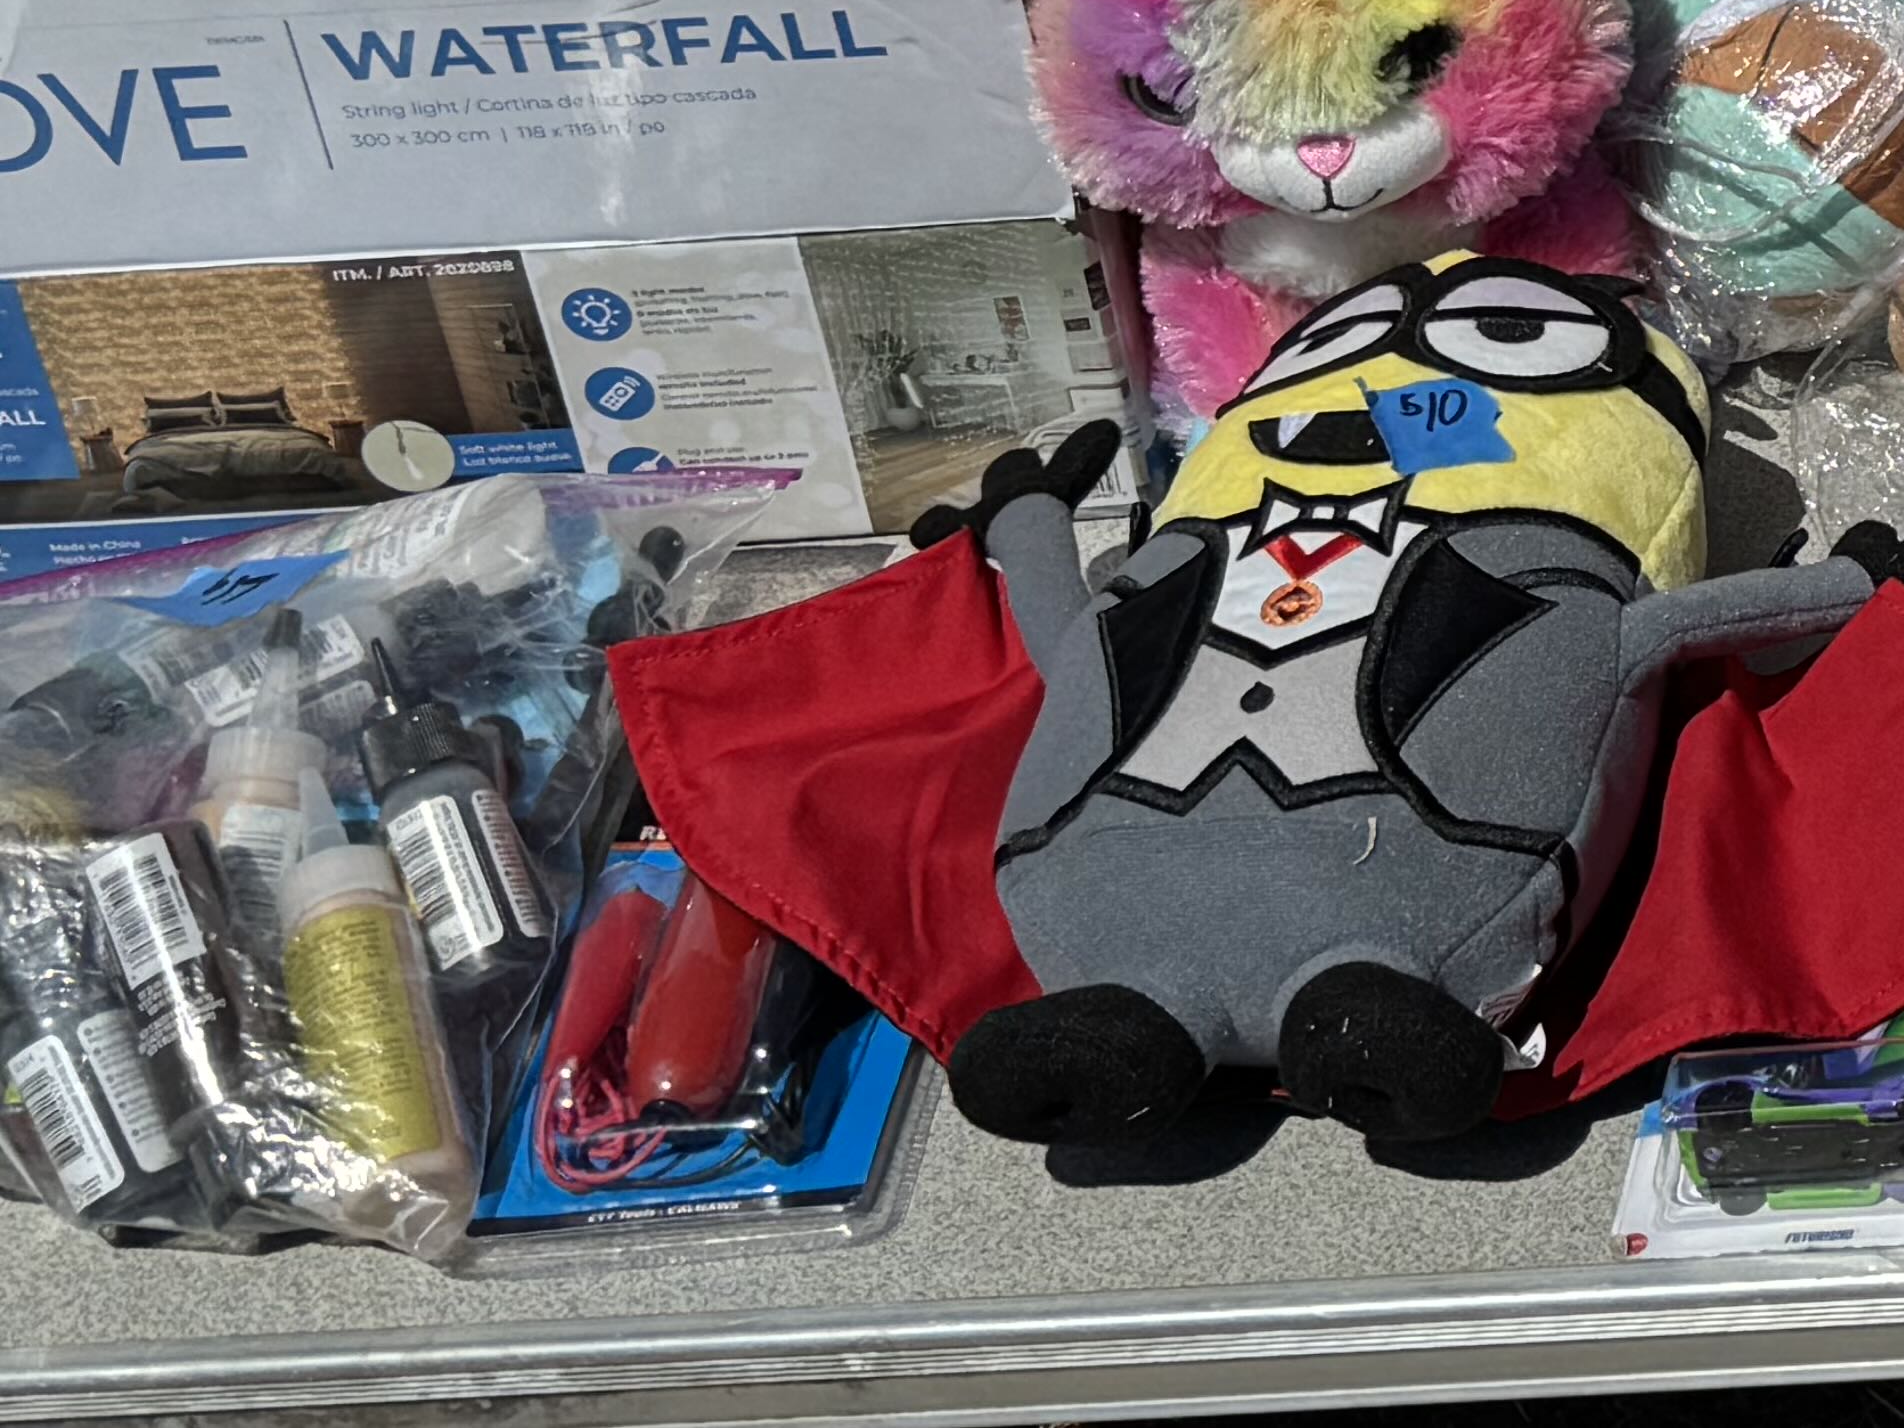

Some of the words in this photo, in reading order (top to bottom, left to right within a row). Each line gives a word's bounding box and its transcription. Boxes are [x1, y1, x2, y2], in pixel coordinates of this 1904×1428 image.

[320, 9, 888, 81] WATERFALL
[342, 99, 406, 122] String
[411, 97, 459, 119] light
[476, 93, 554, 113] Cortina
[558, 93, 583, 110] de
[672, 86, 758, 106] cascada
[351, 130, 391, 149] 300
[411, 128, 453, 146] 300
[457, 128, 490, 143] cm
